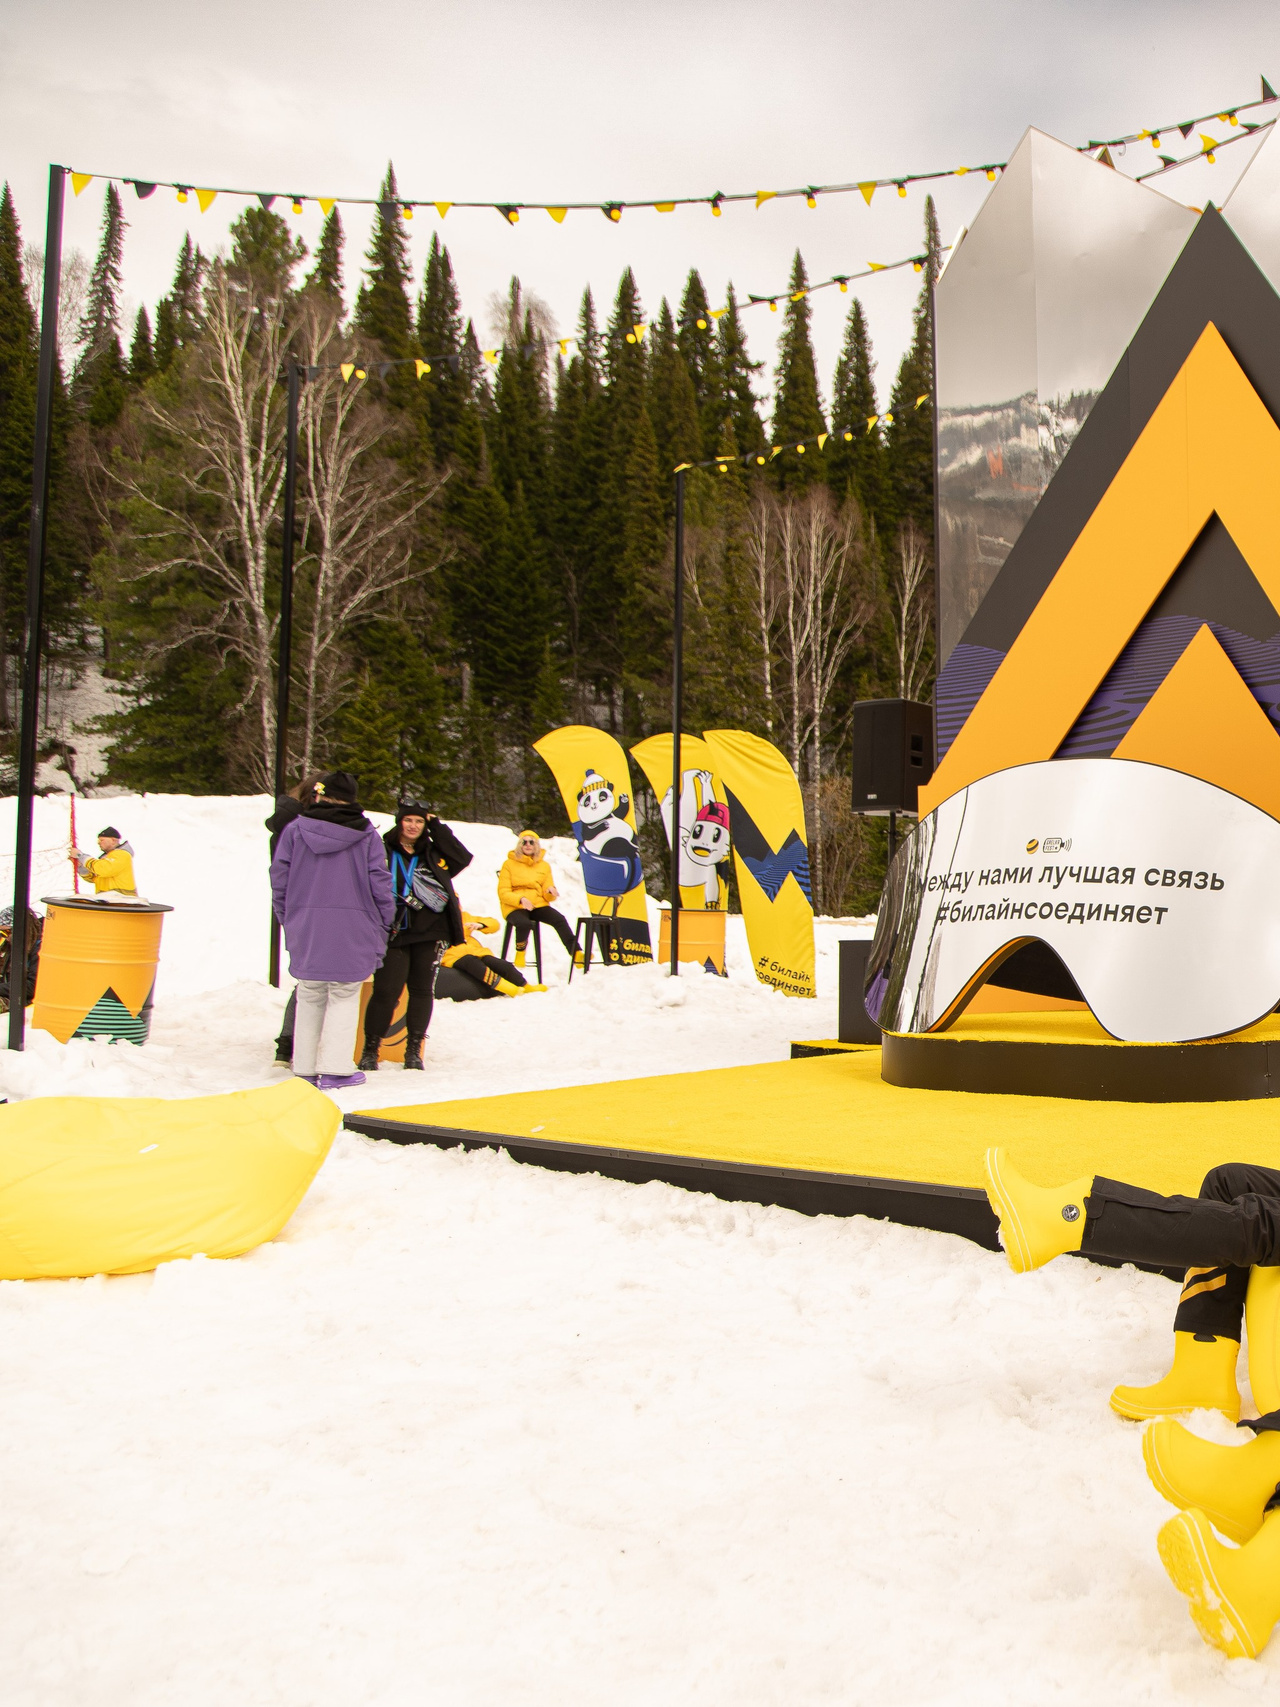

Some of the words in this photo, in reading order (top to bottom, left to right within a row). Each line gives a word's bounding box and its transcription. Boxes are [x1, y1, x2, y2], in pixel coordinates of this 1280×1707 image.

[978, 867, 1034, 887] нами
[1038, 866, 1136, 889] лучшая
[1144, 867, 1225, 891] связь
[937, 897, 1169, 926] #билайнсоединяет
[623, 939, 652, 954] била
